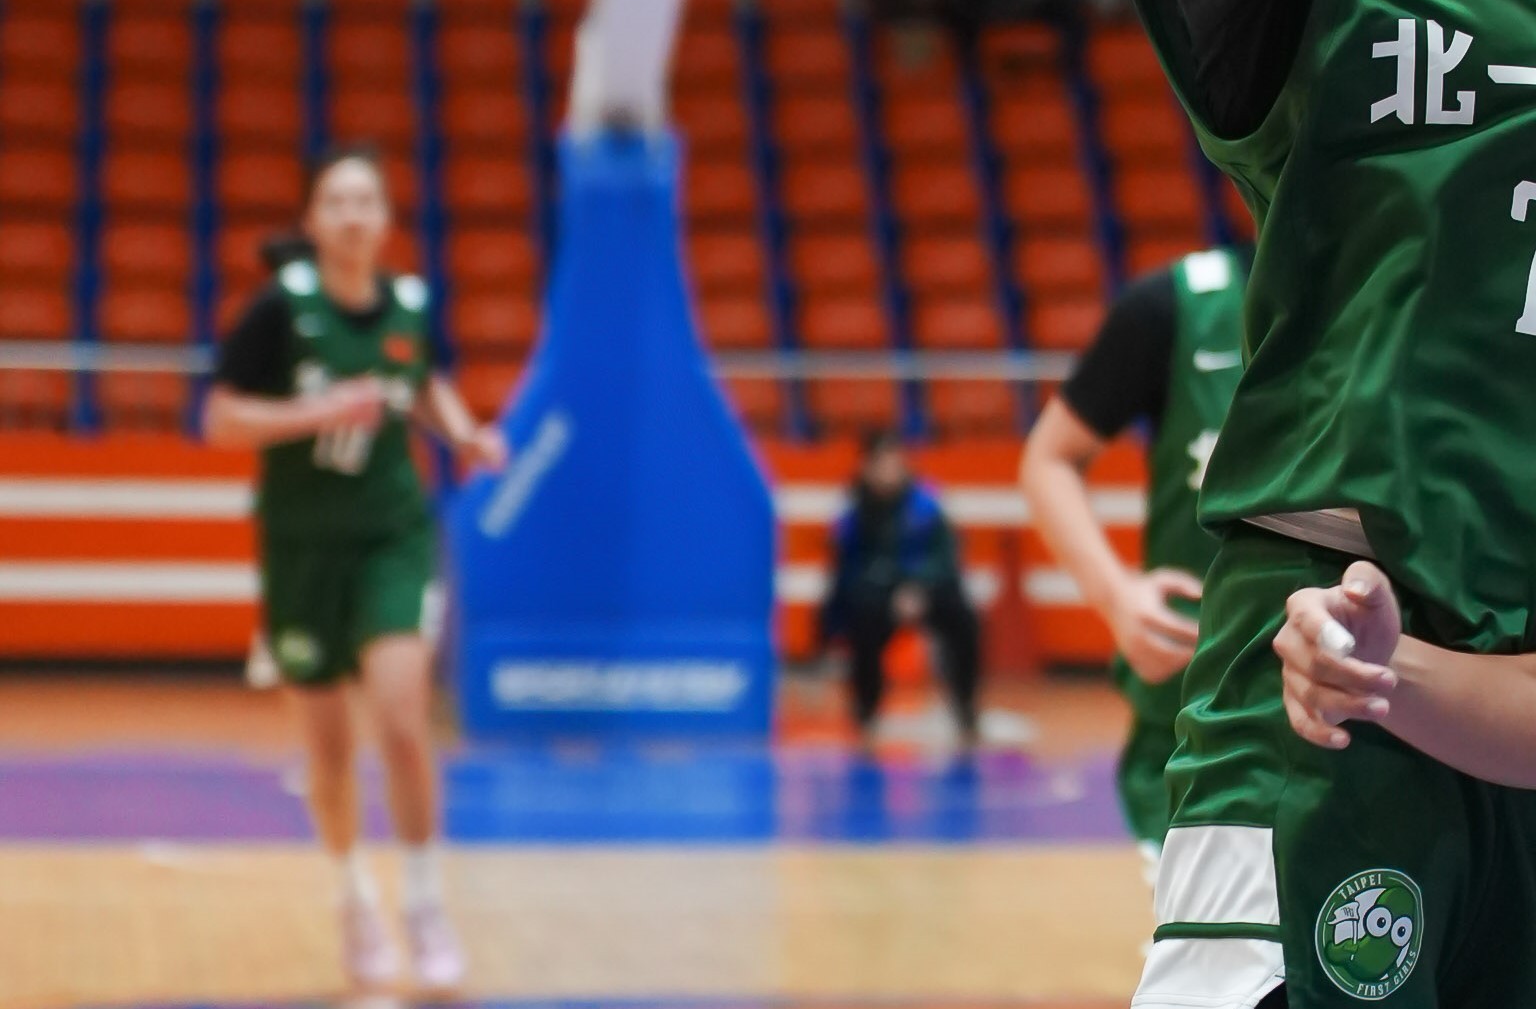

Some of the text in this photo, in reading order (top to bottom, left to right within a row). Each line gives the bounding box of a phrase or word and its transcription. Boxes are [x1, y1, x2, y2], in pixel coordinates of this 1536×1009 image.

[1337, 873, 1382, 900] TAIPEI
[1356, 950, 1417, 997] FIRST GIRLS
